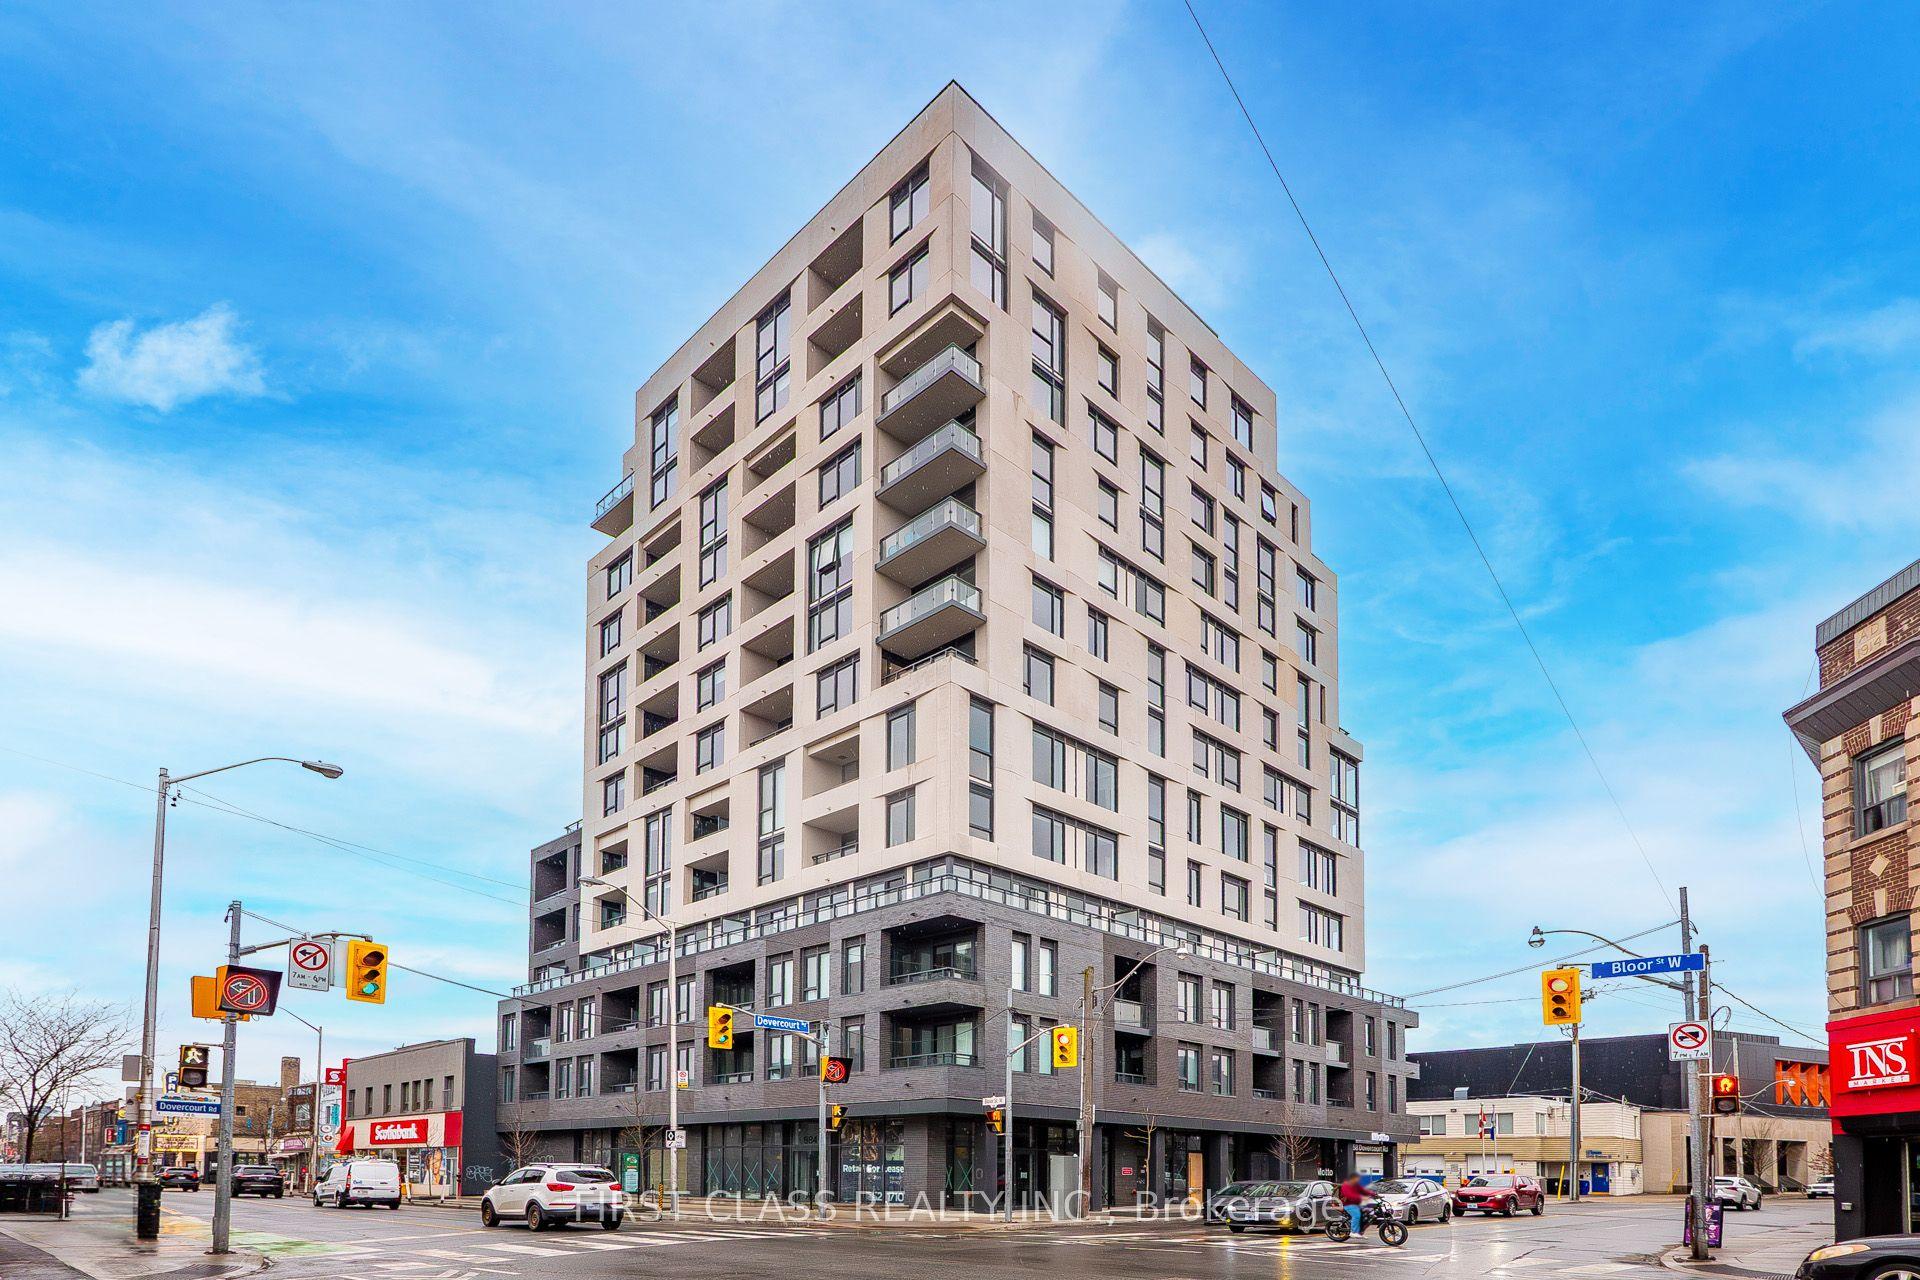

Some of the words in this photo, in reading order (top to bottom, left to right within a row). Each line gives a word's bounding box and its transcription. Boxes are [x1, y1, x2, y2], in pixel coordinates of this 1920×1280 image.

[1612, 960, 1653, 974] Bloor
[1667, 957, 1682, 968] W
[757, 1016, 800, 1030] Dovercourt
[1848, 1041, 1907, 1080] INS
[1853, 1076, 1904, 1086] MARKET
[160, 1102, 206, 1112] Dovercourt
[208, 1105, 217, 1113] Rd
[375, 1123, 418, 1140] Scotiabank
